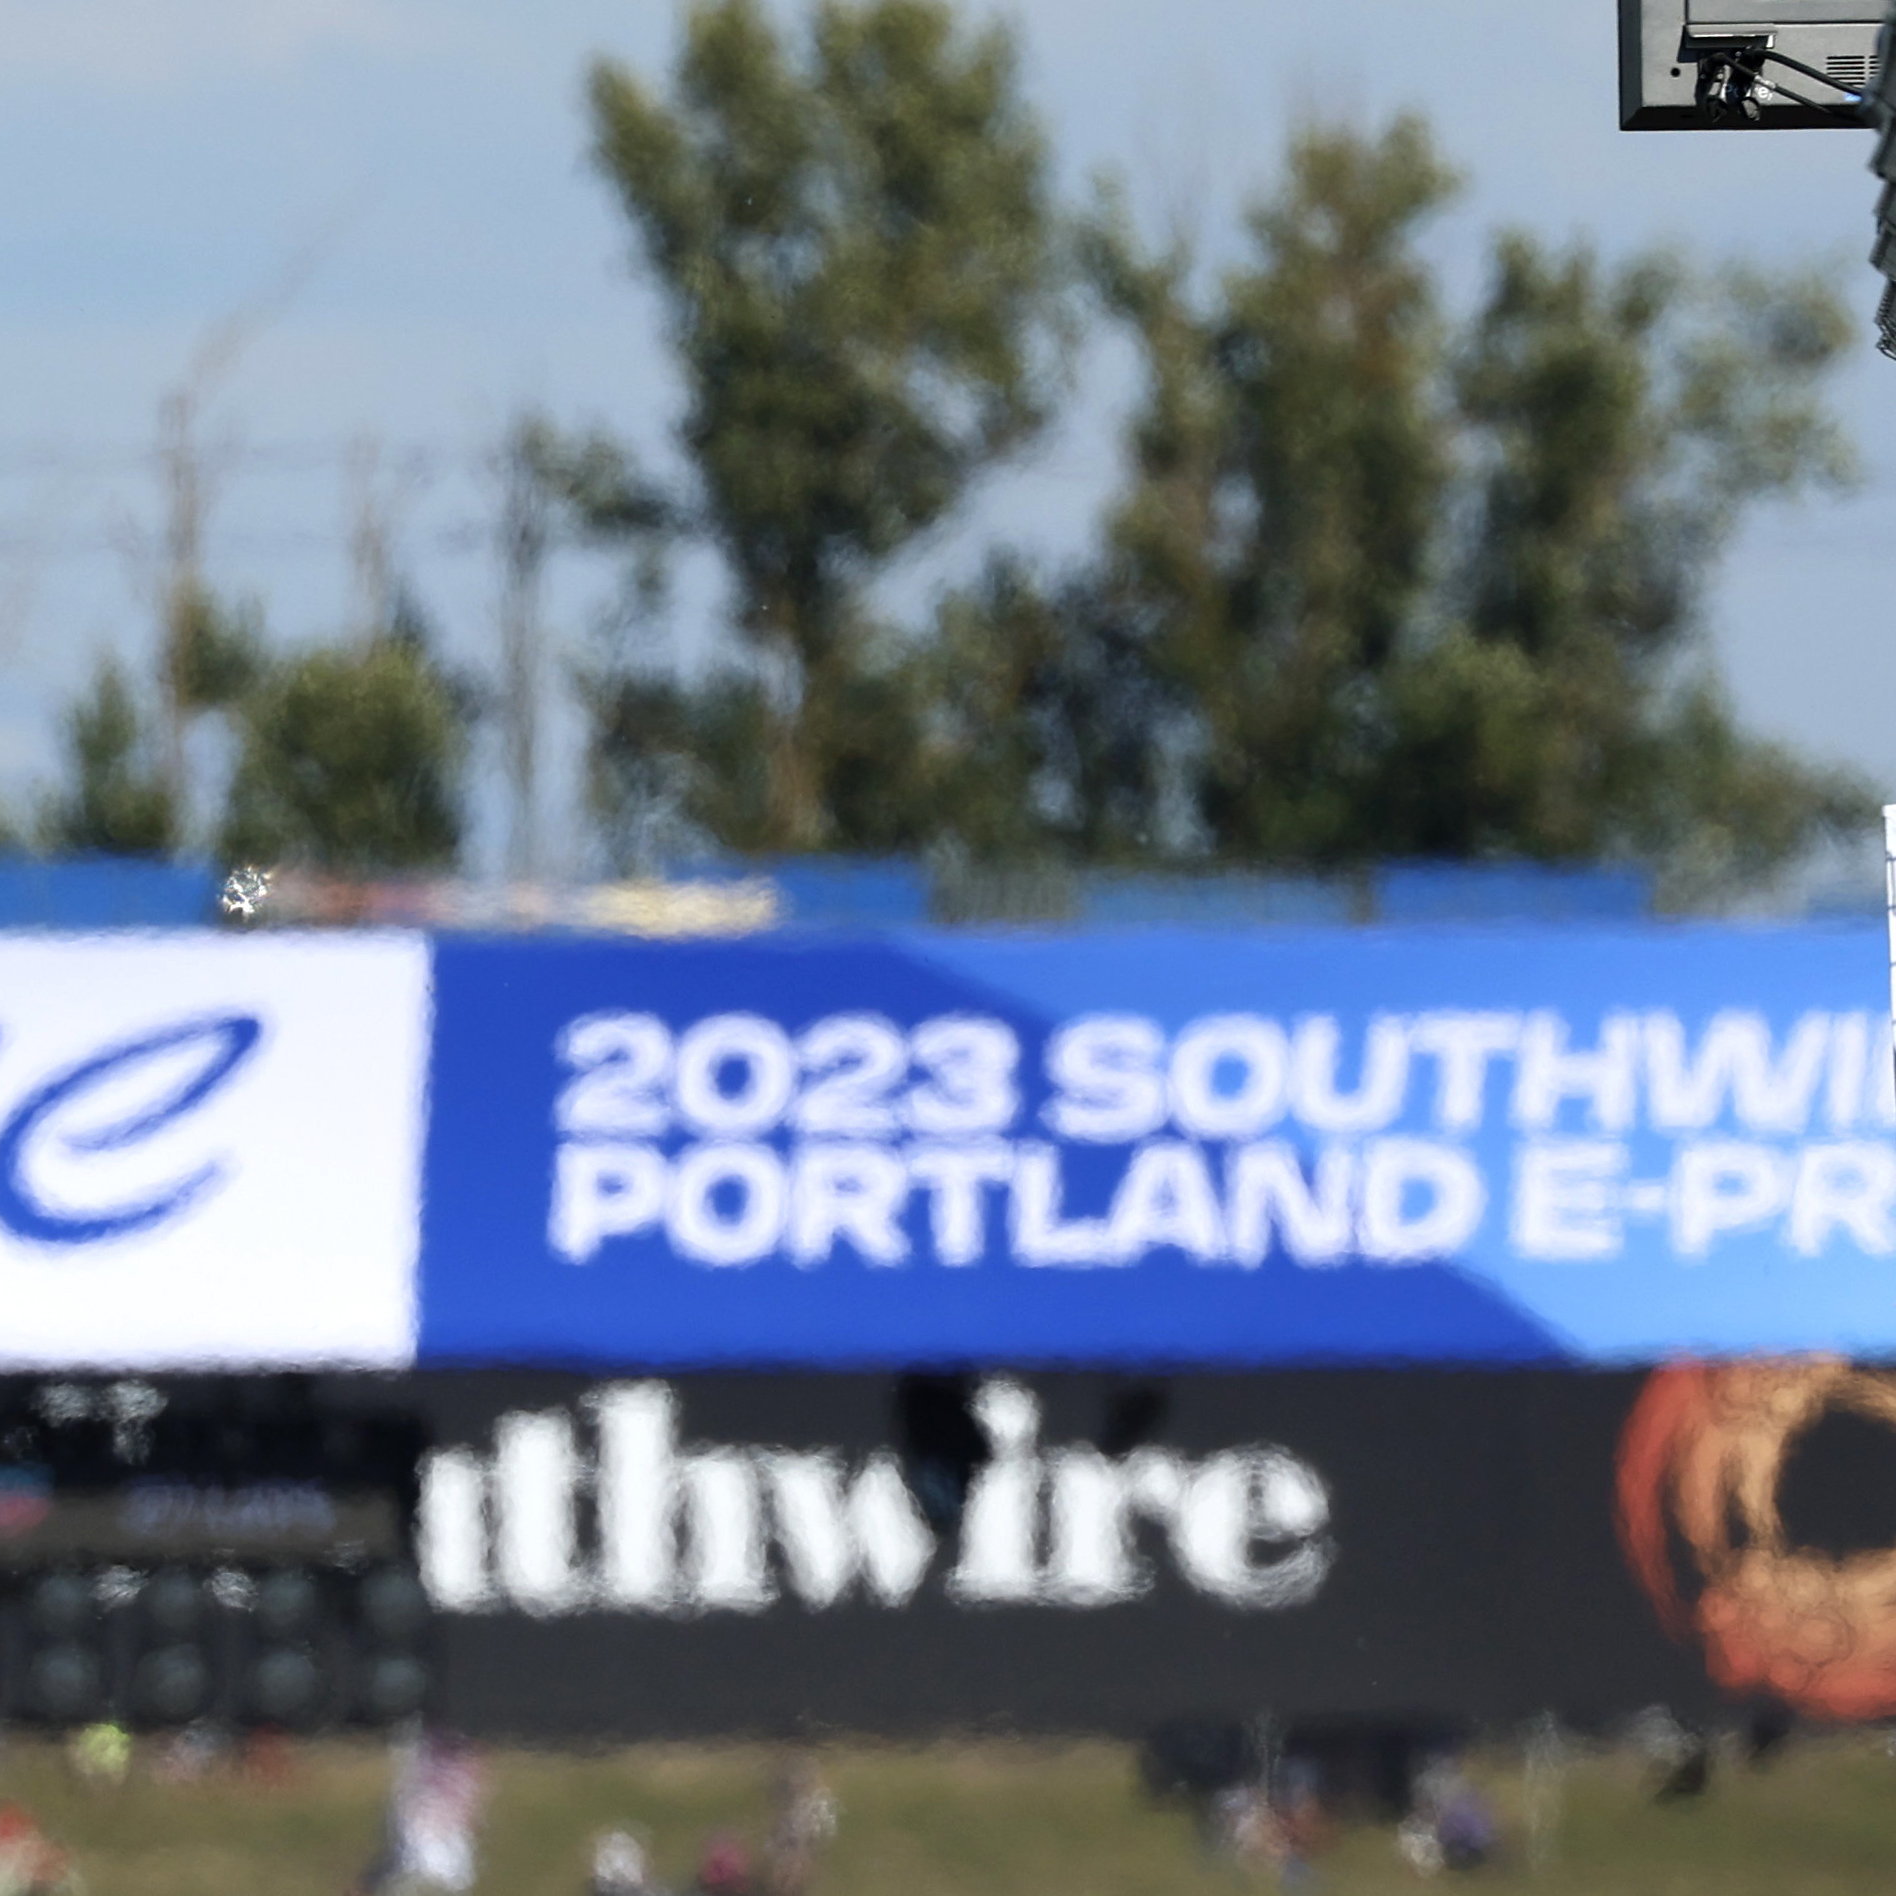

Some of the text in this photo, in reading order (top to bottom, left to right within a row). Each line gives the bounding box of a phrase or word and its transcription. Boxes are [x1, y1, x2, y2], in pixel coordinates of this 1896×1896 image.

[555, 1012, 1020, 1138] 2023
[548, 1138, 1896, 1267] PORTLAND E-PR
